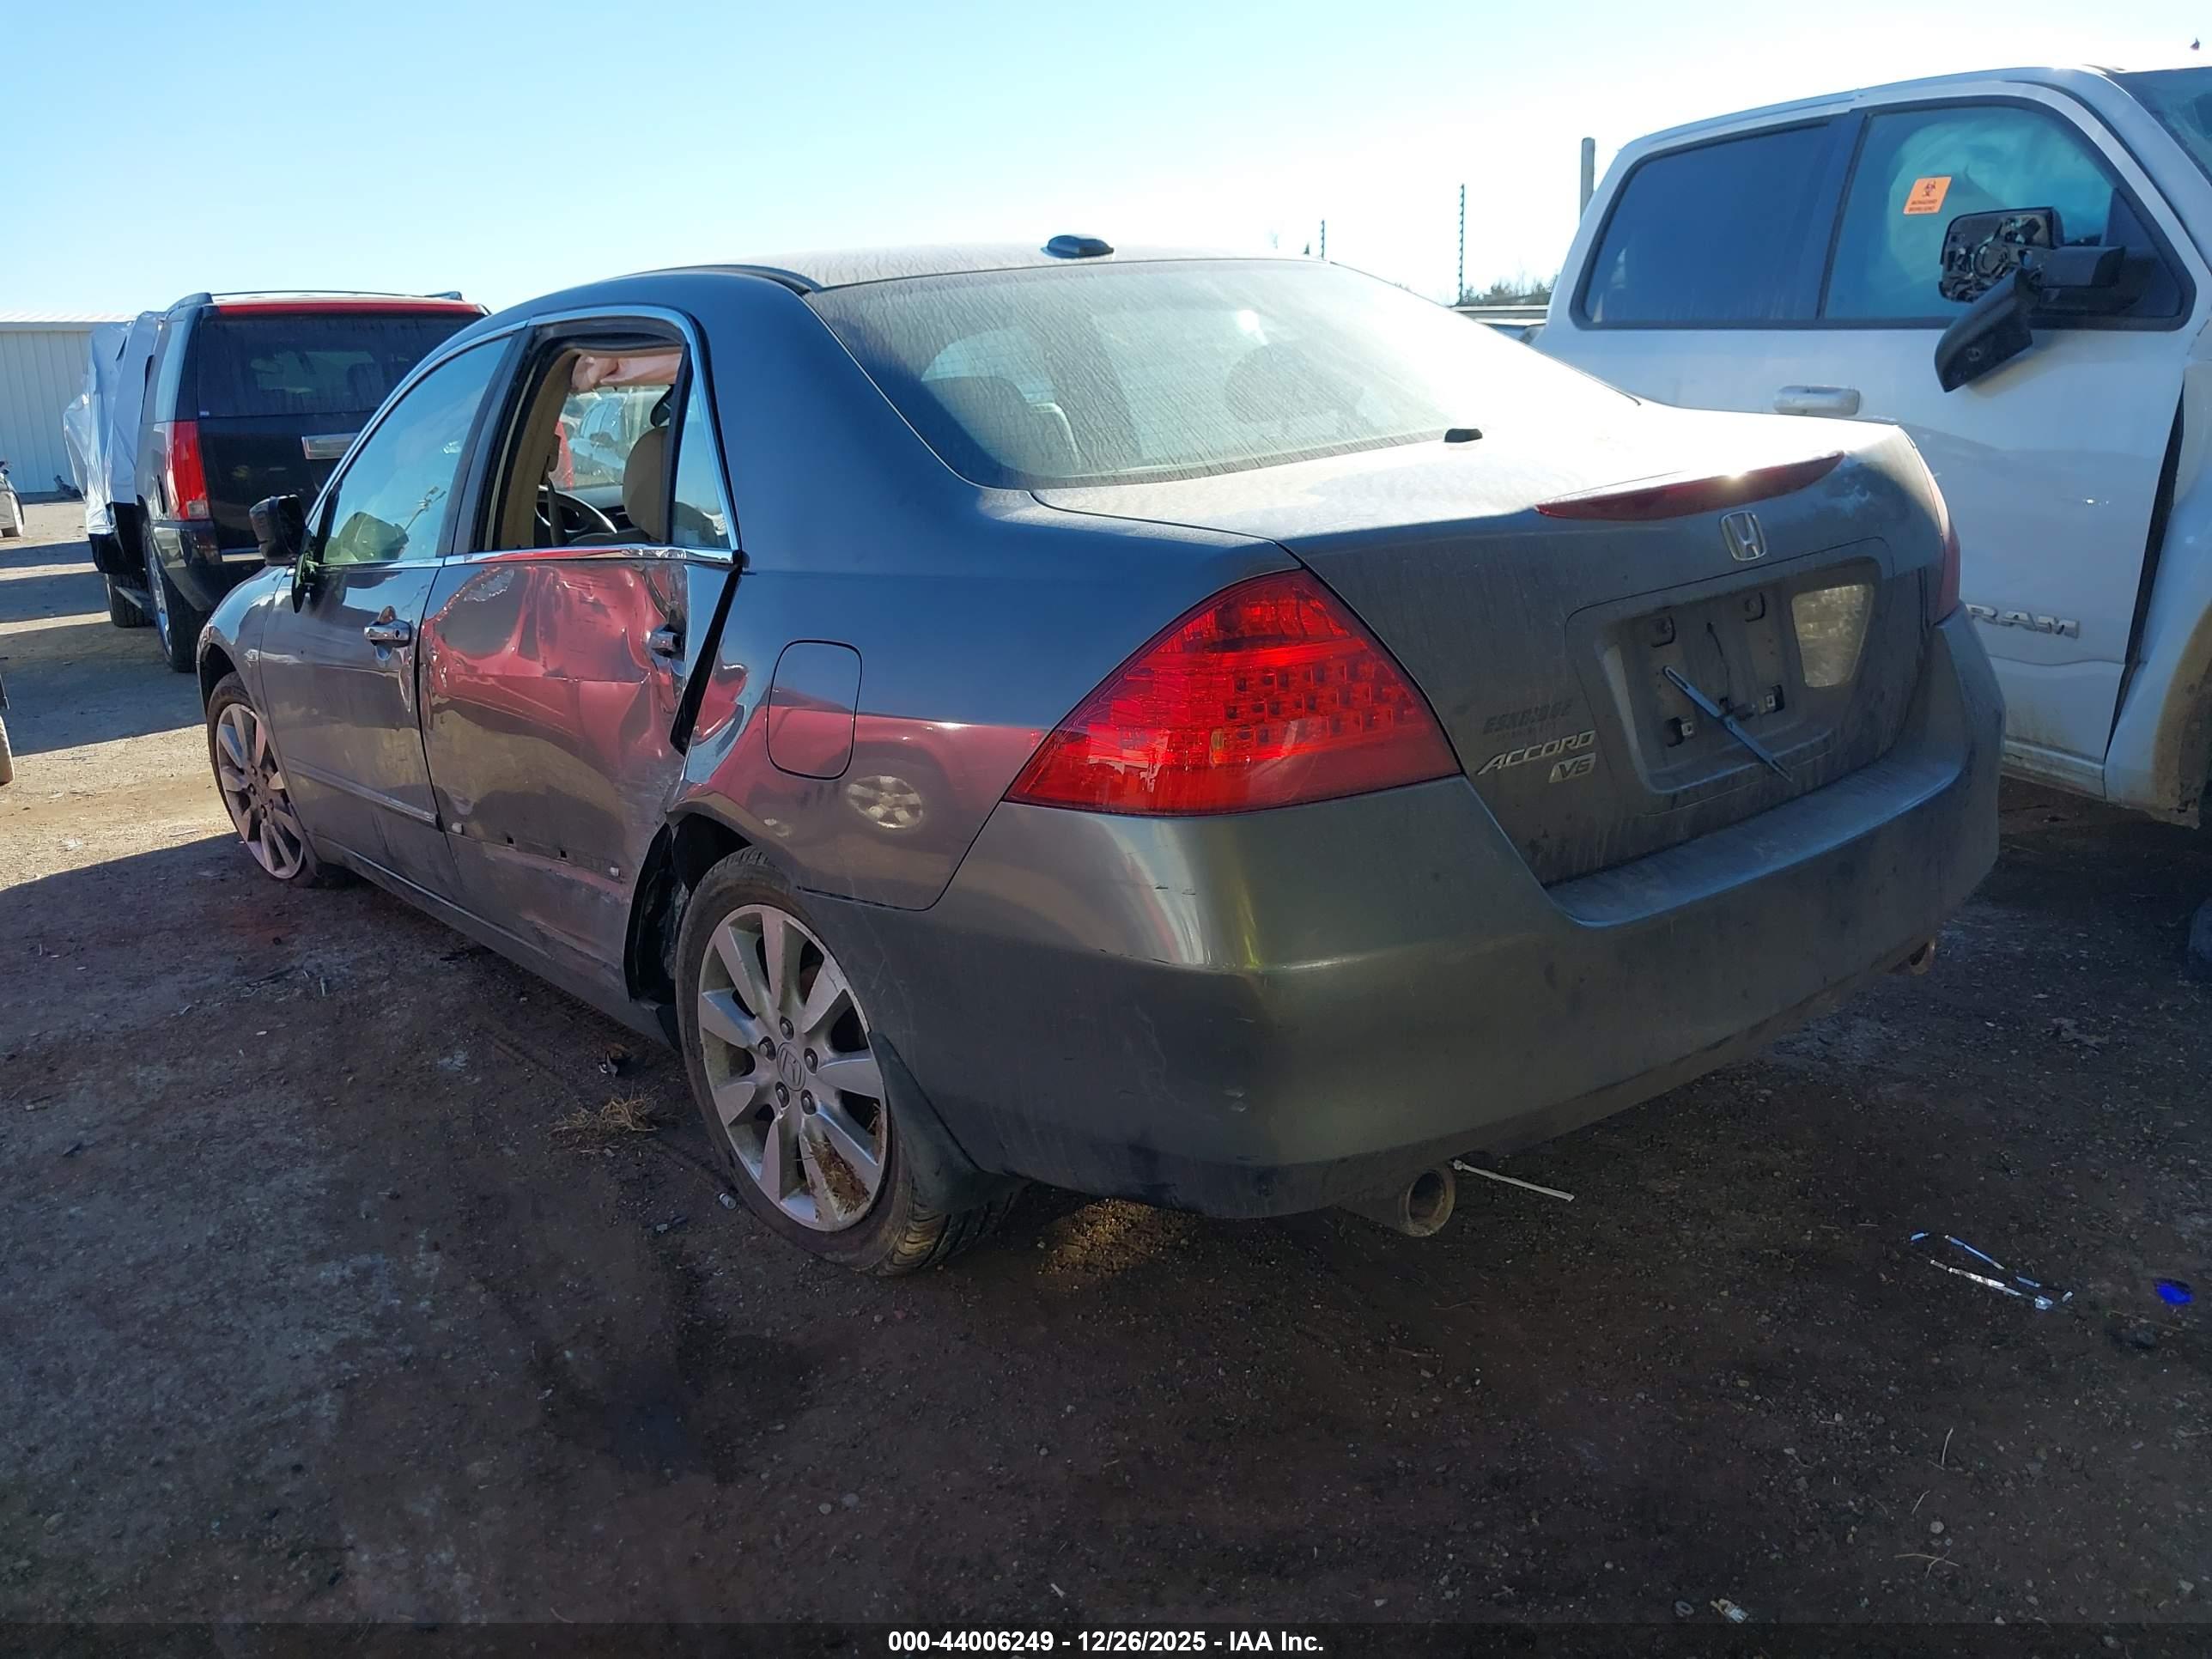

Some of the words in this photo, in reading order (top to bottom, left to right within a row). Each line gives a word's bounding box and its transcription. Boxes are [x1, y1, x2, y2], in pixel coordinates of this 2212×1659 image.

[1966, 604, 2080, 639] RAM
[1476, 730, 1595, 775] ACCORD
[1555, 755, 1595, 781] V6
